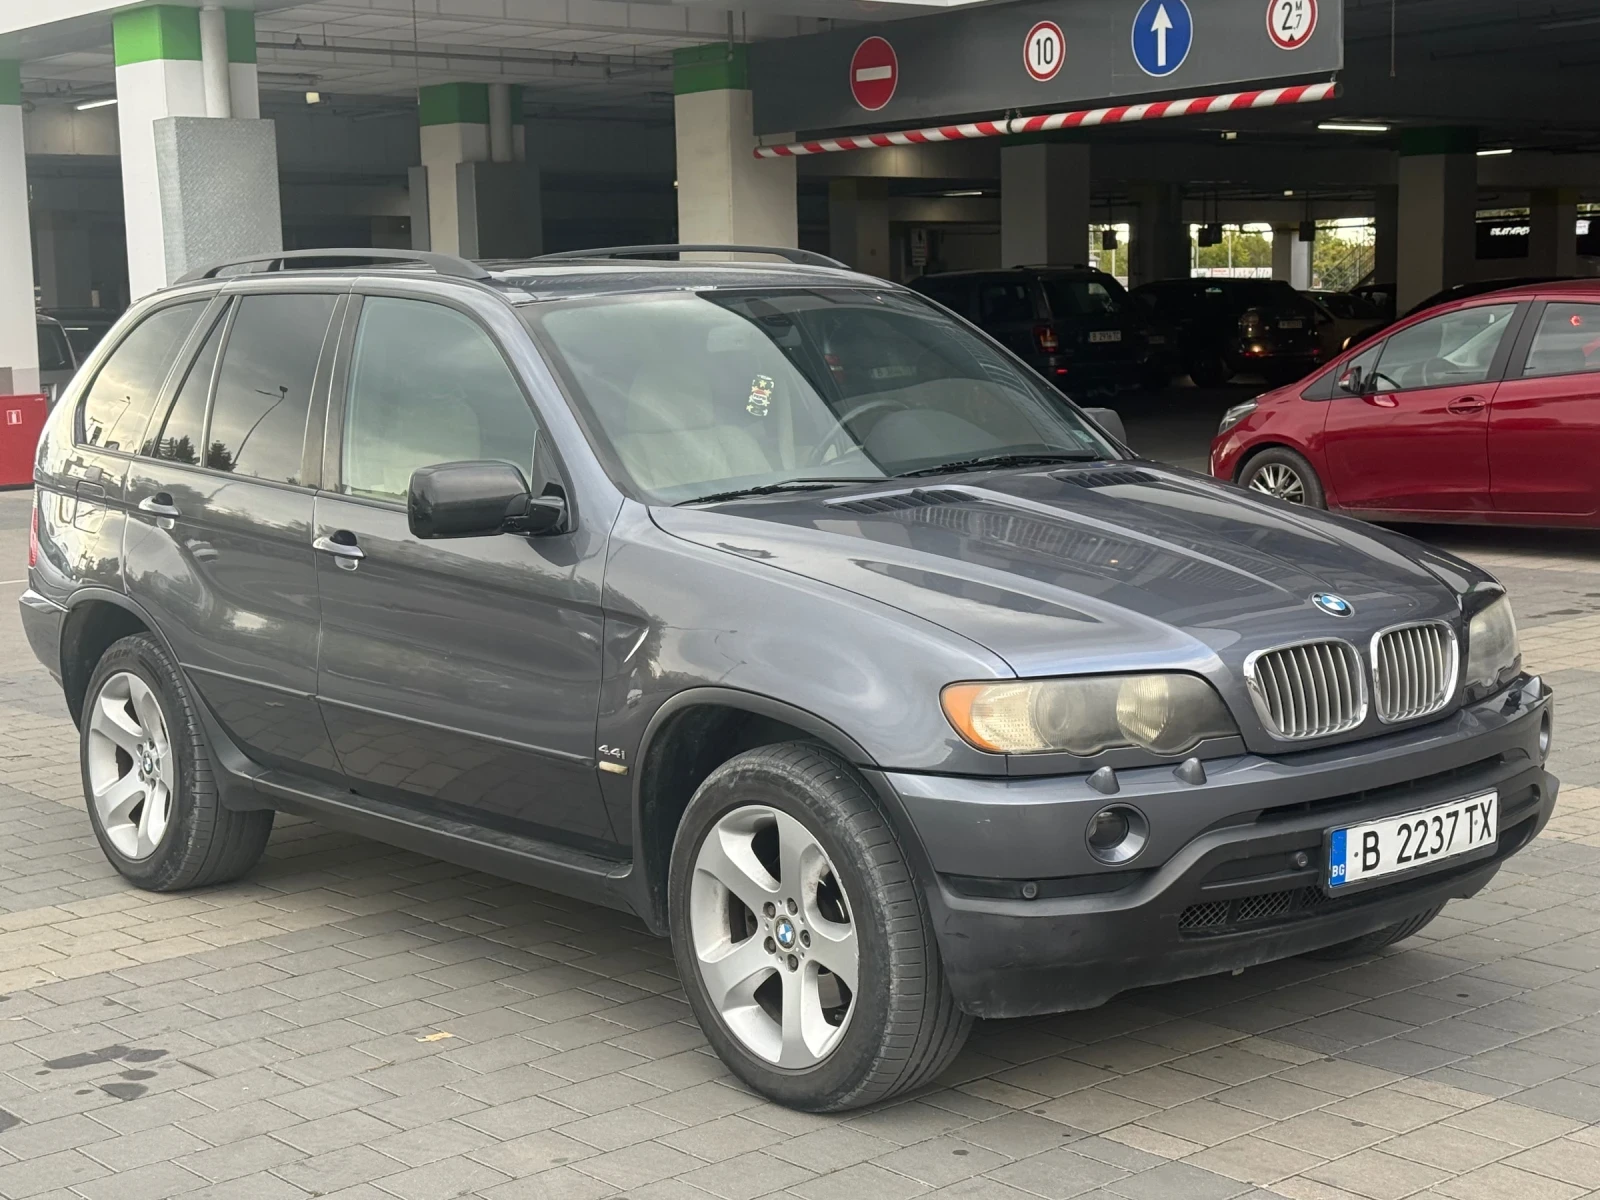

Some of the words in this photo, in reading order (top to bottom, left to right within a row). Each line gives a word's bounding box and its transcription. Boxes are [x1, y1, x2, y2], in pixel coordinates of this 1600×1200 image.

[1036, 37, 1053, 66] 10
[1362, 830, 1380, 872] B
[1397, 810, 1459, 865] 2237
[1465, 799, 1493, 844] TX
[1332, 864, 1345, 878] BG
